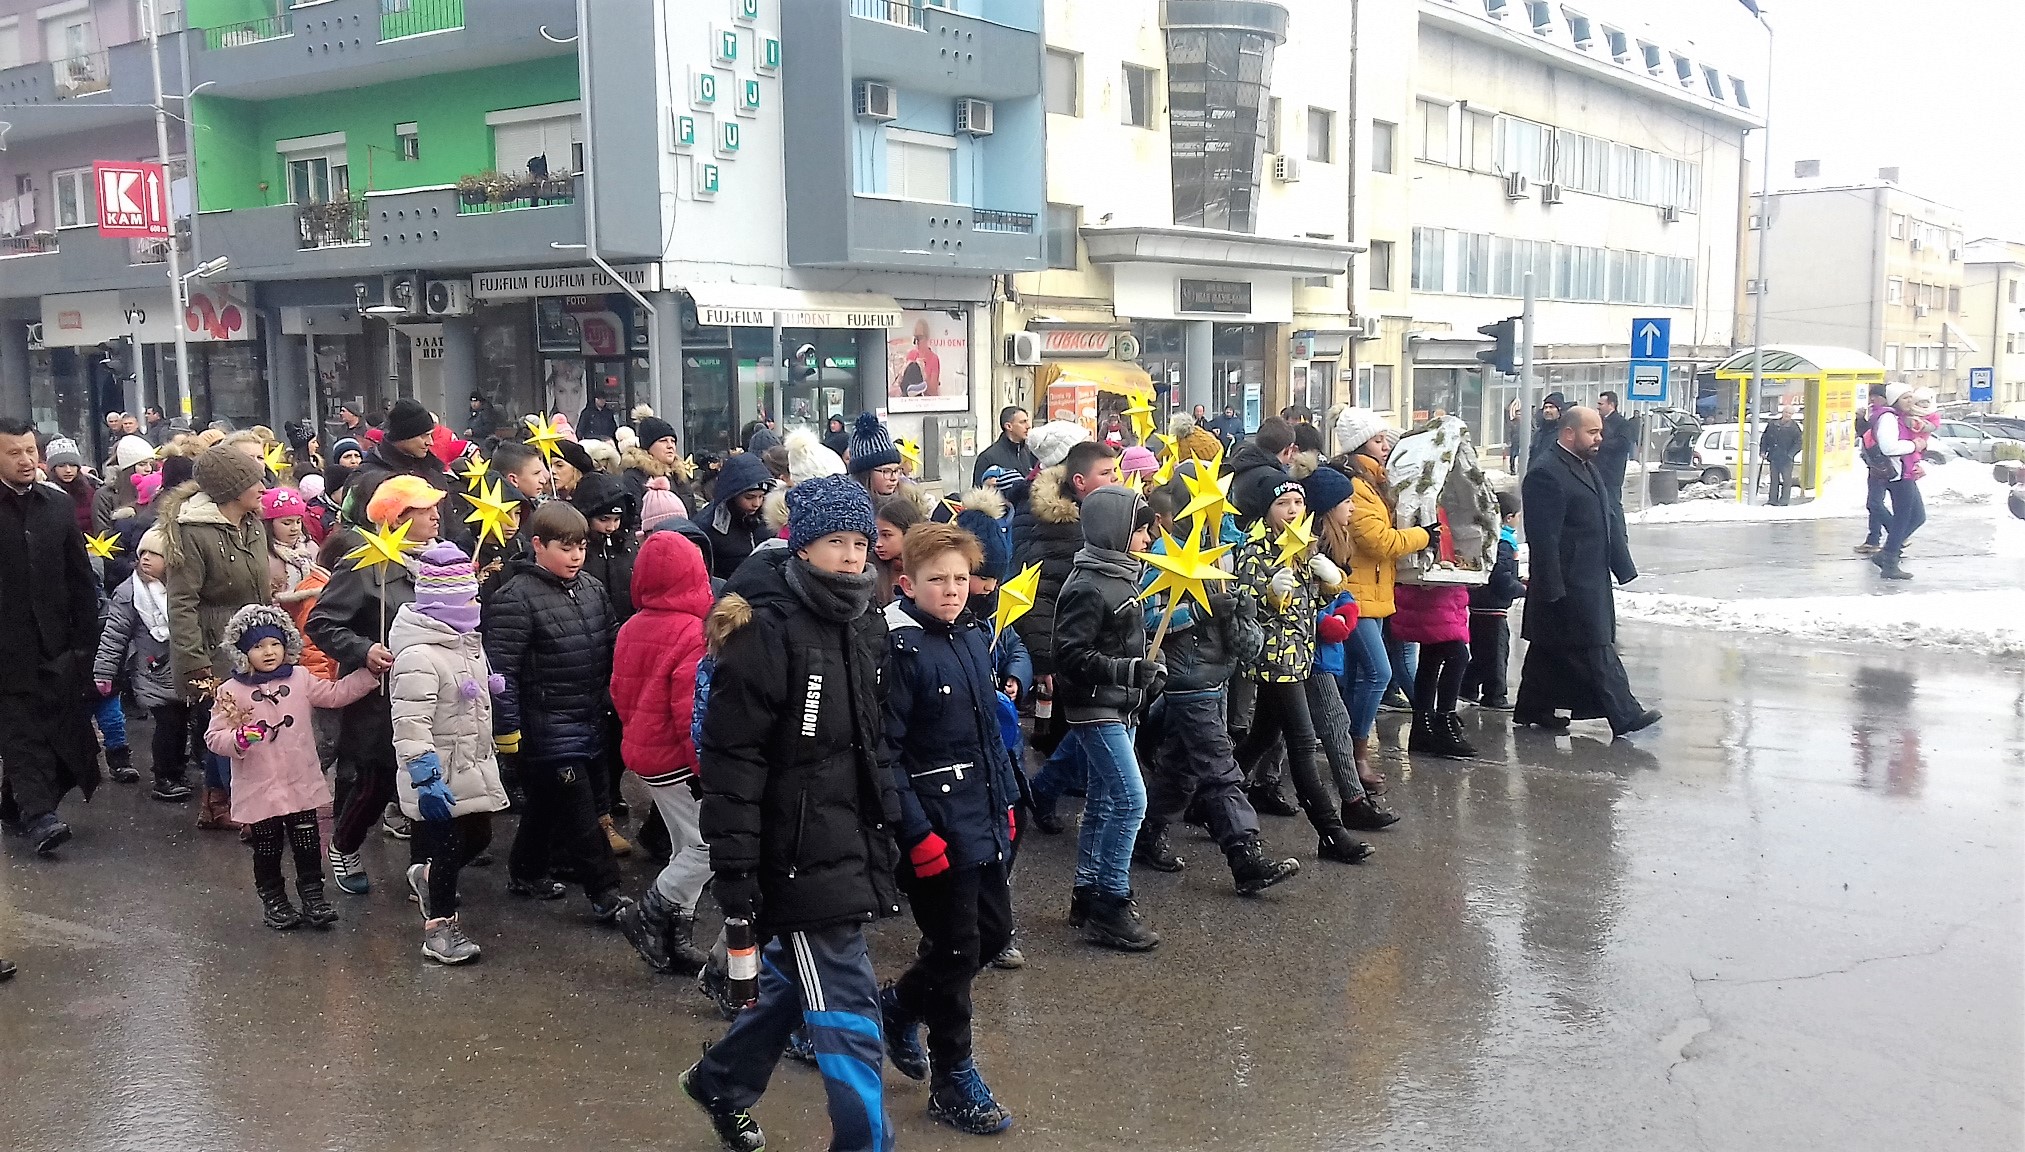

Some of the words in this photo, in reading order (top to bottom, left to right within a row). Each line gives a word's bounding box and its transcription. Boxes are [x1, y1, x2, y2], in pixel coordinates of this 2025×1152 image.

[107, 212, 143, 225] KAM
[479, 276, 528, 291] FUJIFILM
[534, 273, 585, 288] FUJIFILM
[592, 270, 645, 286] FUJFILM
[566, 296, 587, 305] FOTO
[706, 309, 763, 324] FUJIFILM
[847, 313, 895, 326] FUJIFILM
[929, 338, 946, 347] FUJI
[947, 339, 966, 347] DENT
[1046, 331, 1109, 350] TOBACCO
[801, 674, 823, 737] FASHION!
